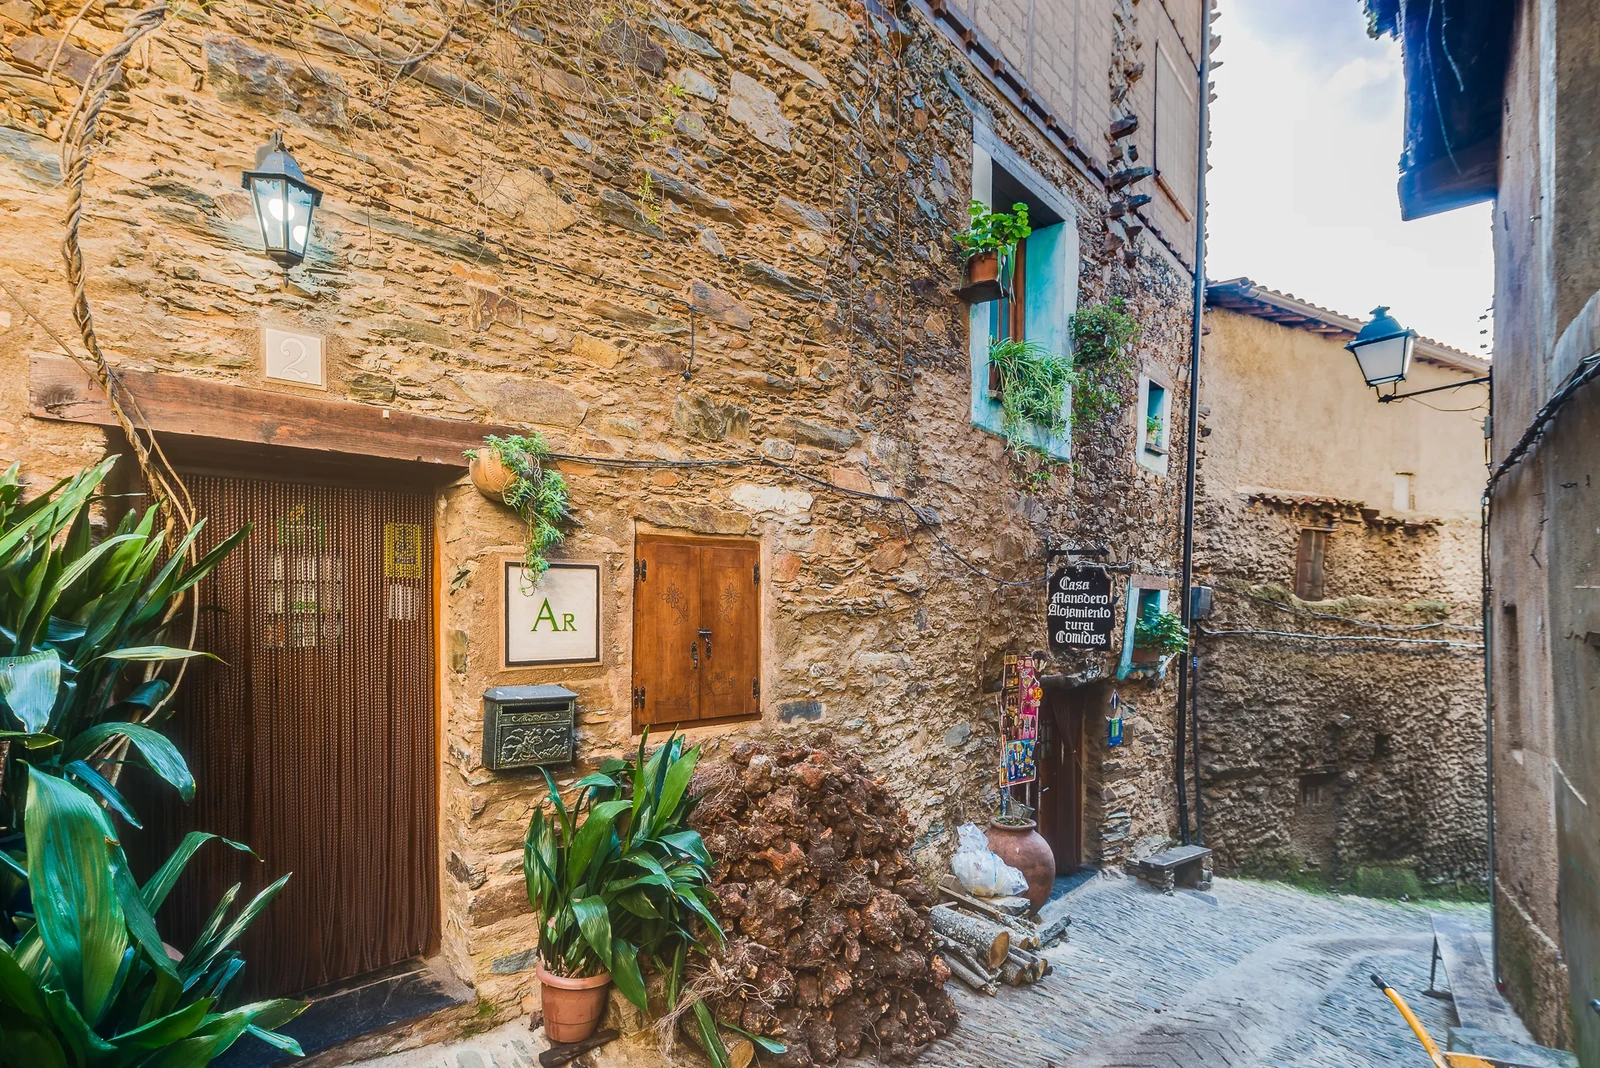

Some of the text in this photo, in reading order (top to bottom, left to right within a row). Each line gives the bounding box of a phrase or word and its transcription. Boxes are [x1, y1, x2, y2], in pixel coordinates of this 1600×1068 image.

[280, 336, 309, 380] 2
[1059, 576, 1090, 591] Casa
[1051, 592, 1109, 605] Manadero
[1047, 603, 1112, 619] Alojamiento
[1065, 621, 1095, 632] rural
[1055, 630, 1107, 646] Comidas
